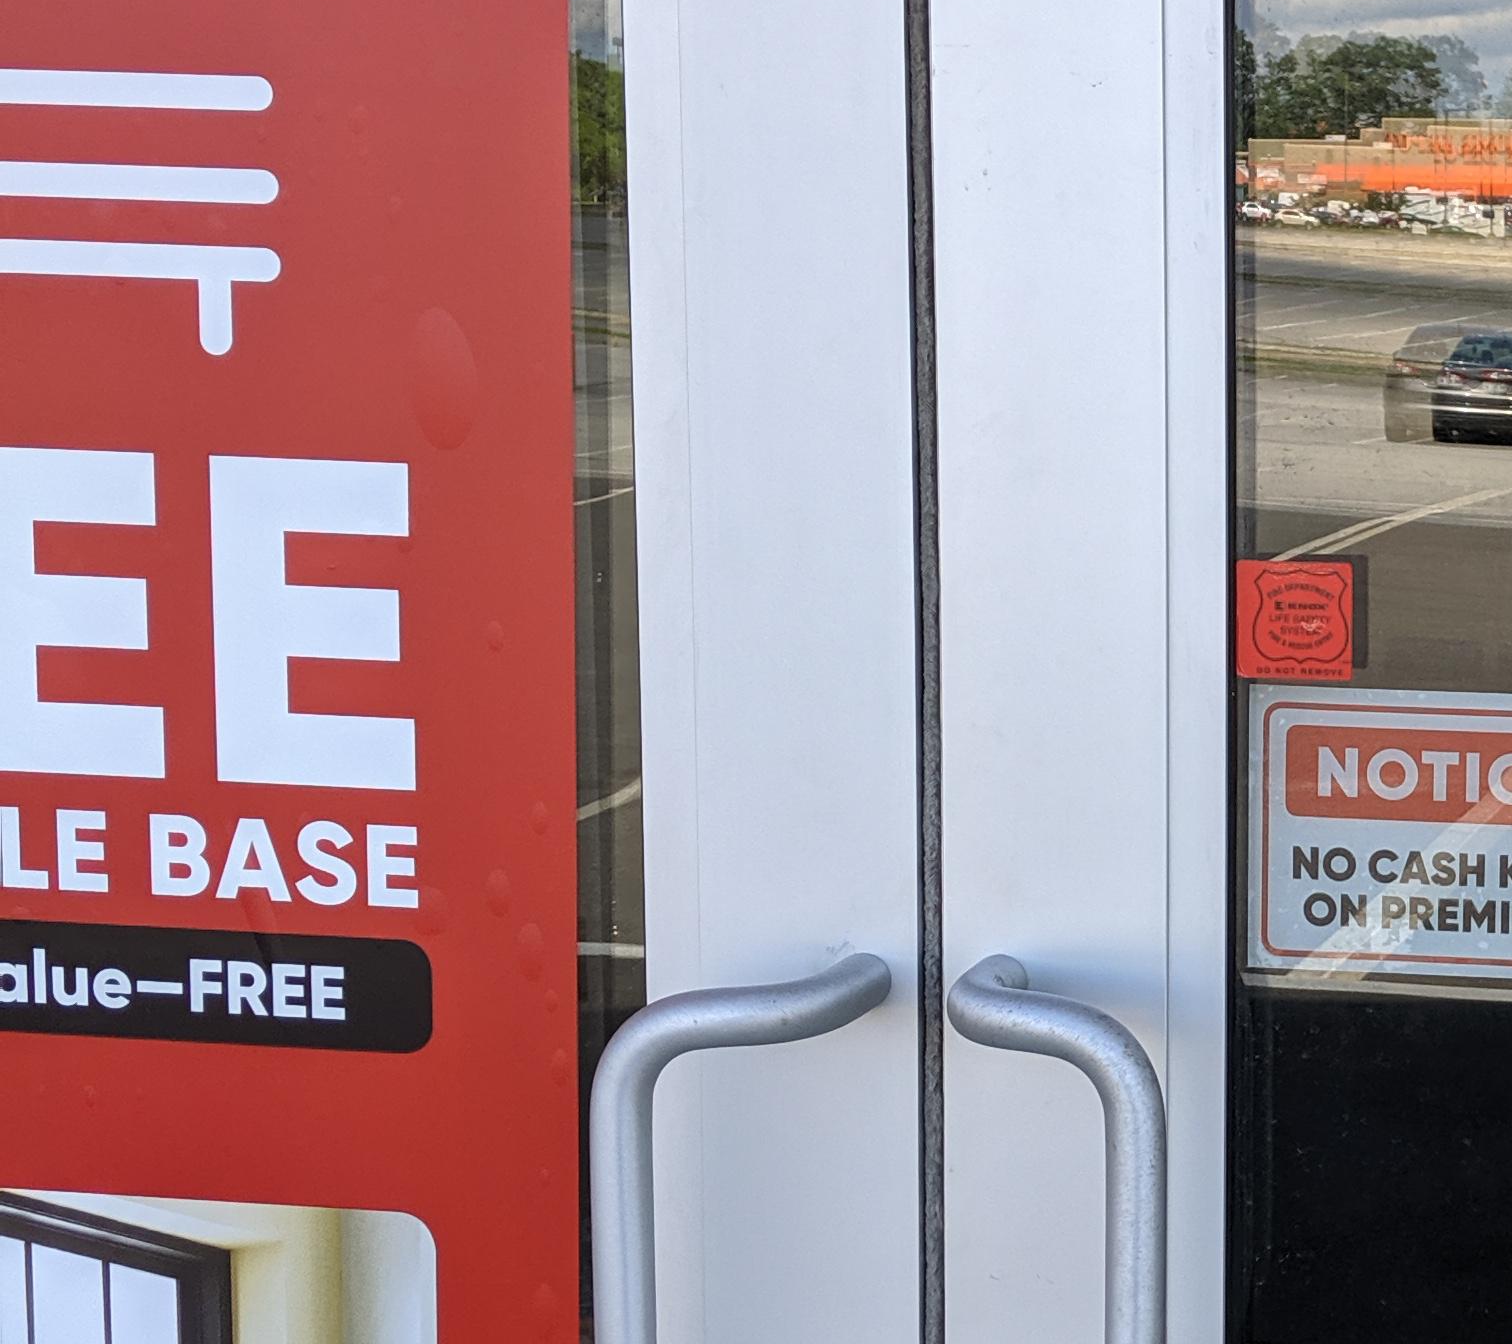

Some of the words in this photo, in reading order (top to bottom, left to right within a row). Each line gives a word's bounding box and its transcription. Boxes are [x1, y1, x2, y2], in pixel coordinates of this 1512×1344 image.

[0, 446, 416, 791] EE
[1275, 666, 1296, 675] NOT
[0, 805, 110, 894] LE
[148, 812, 420, 909] BASE
[1291, 845, 1357, 882] NO
[1367, 849, 1487, 888] CASH
[1302, 892, 1367, 928] ON
